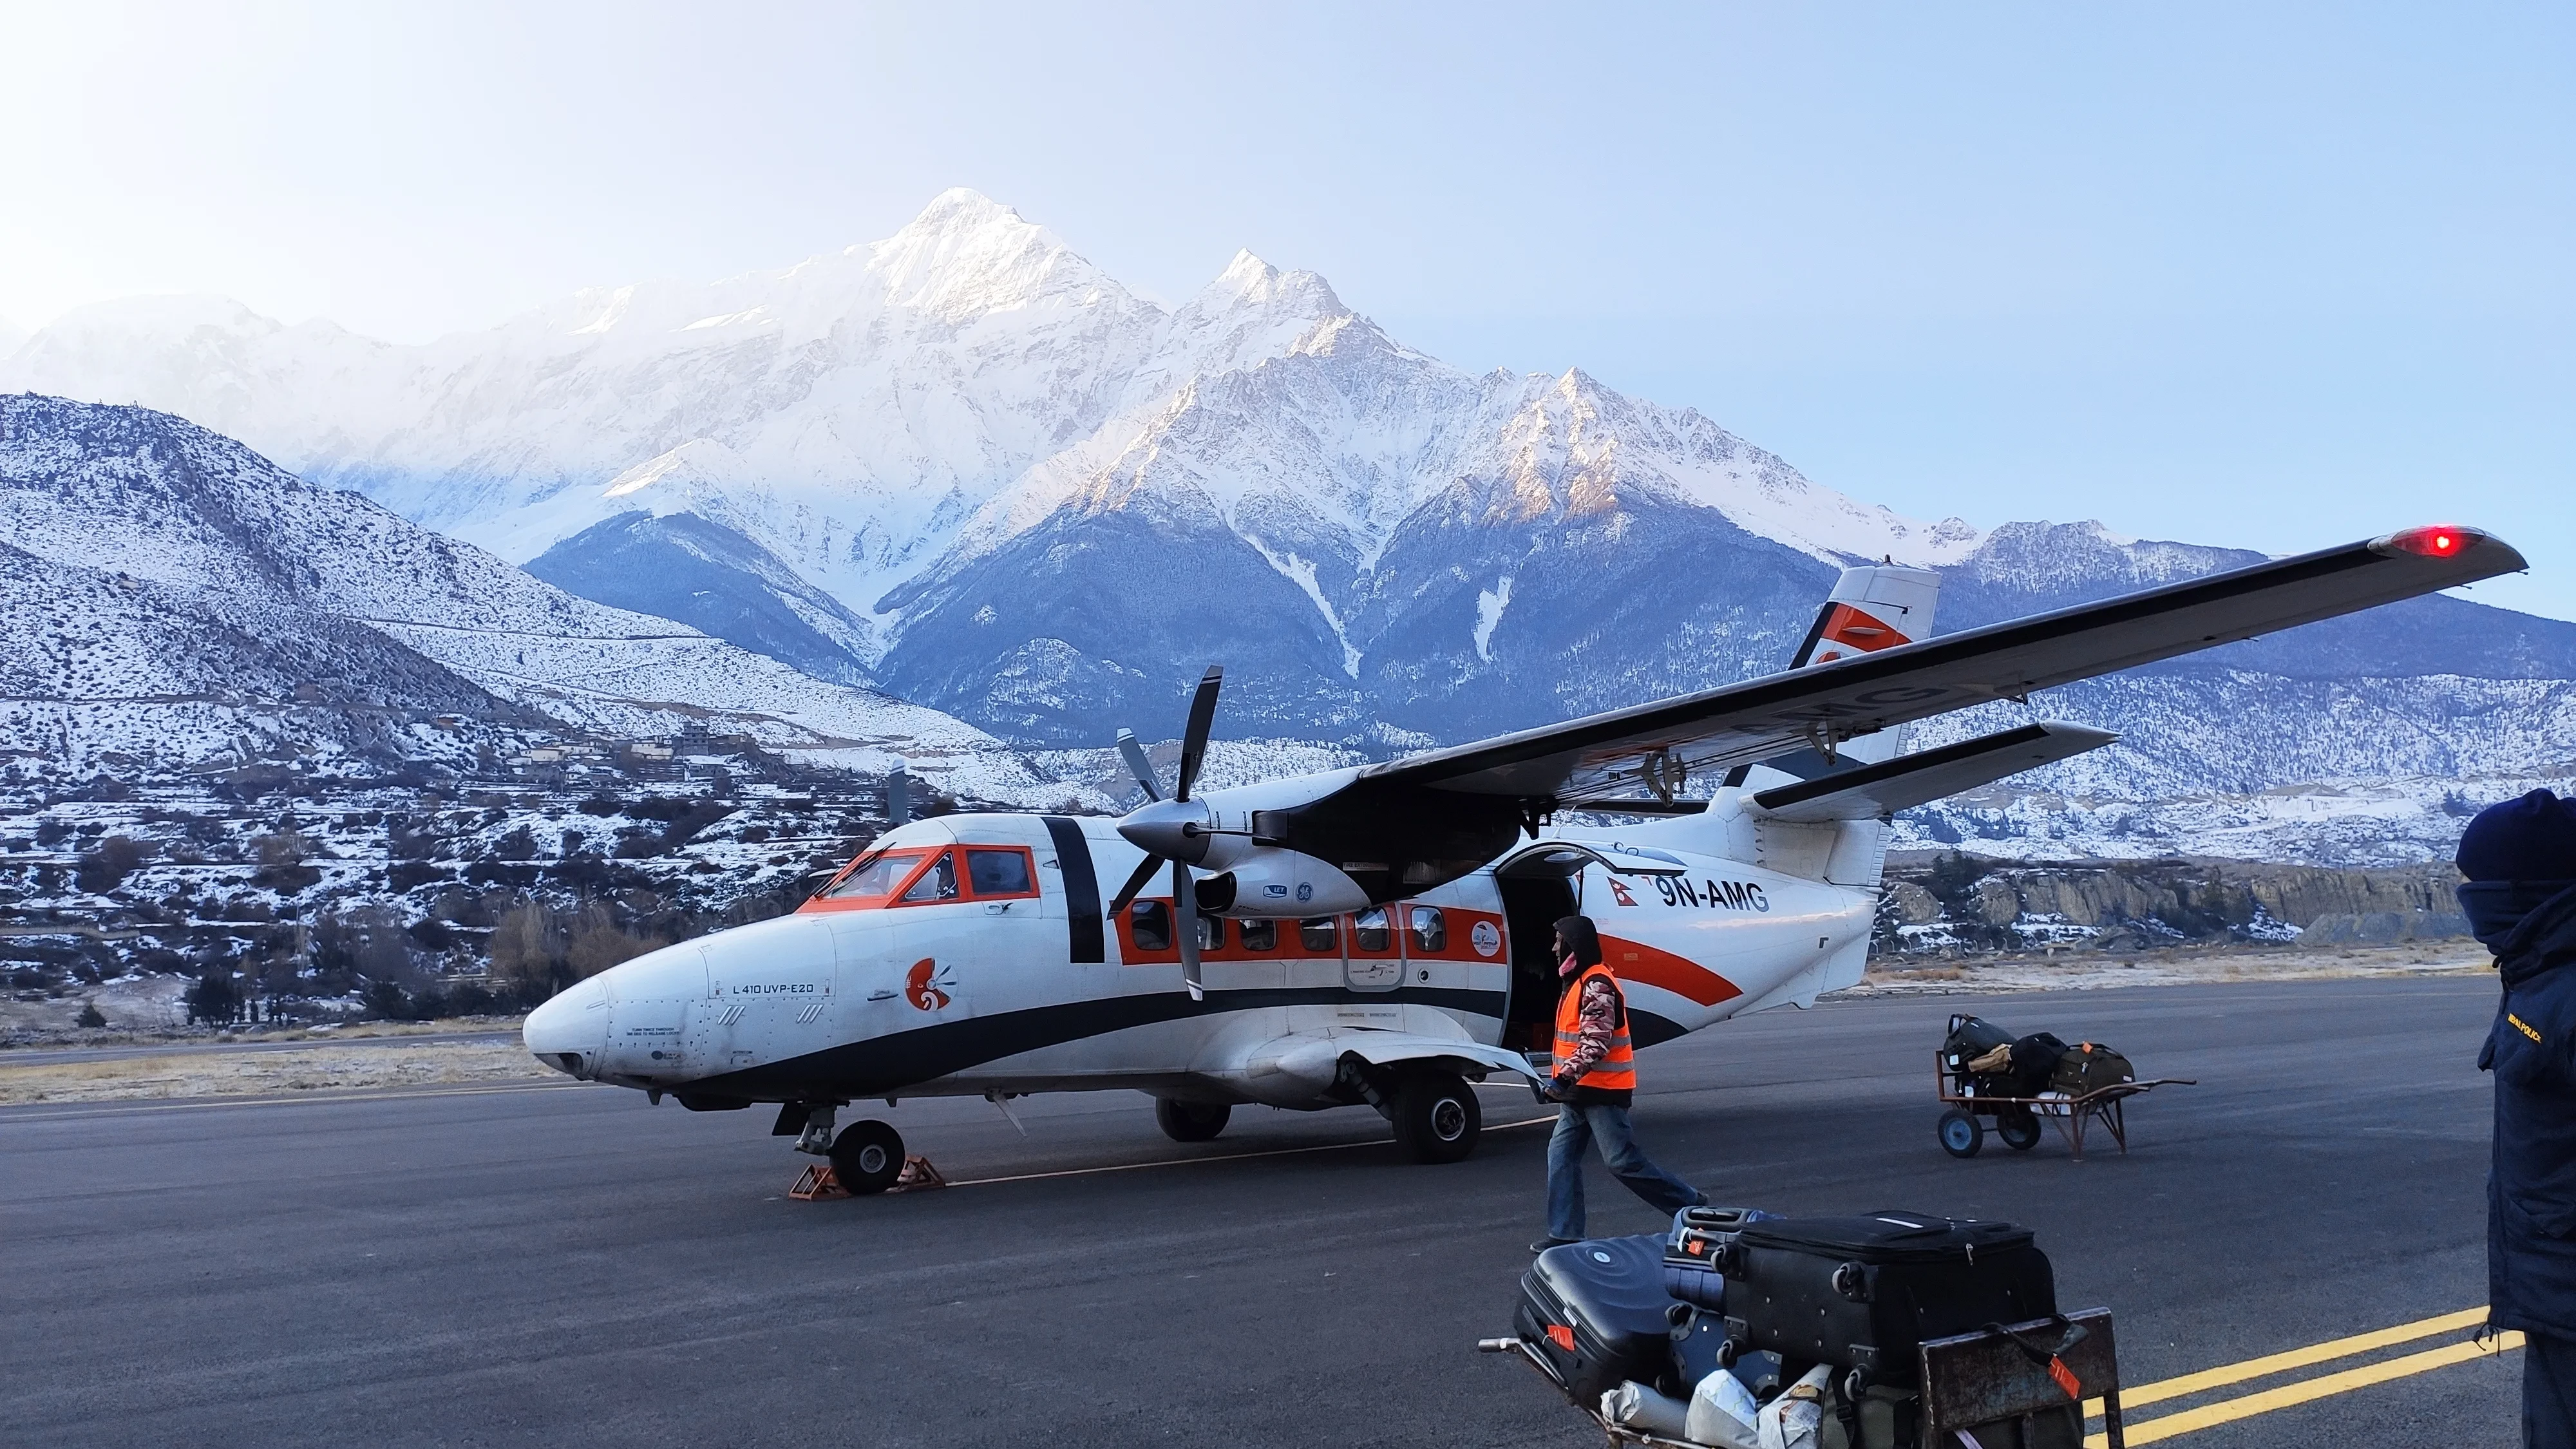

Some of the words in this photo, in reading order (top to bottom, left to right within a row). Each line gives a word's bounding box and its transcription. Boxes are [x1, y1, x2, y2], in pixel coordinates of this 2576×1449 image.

[1655, 876, 1770, 912] 9N-AMG
[733, 985, 740, 994] L
[742, 985, 761, 994] 410
[764, 984, 813, 993] UVP-E20
